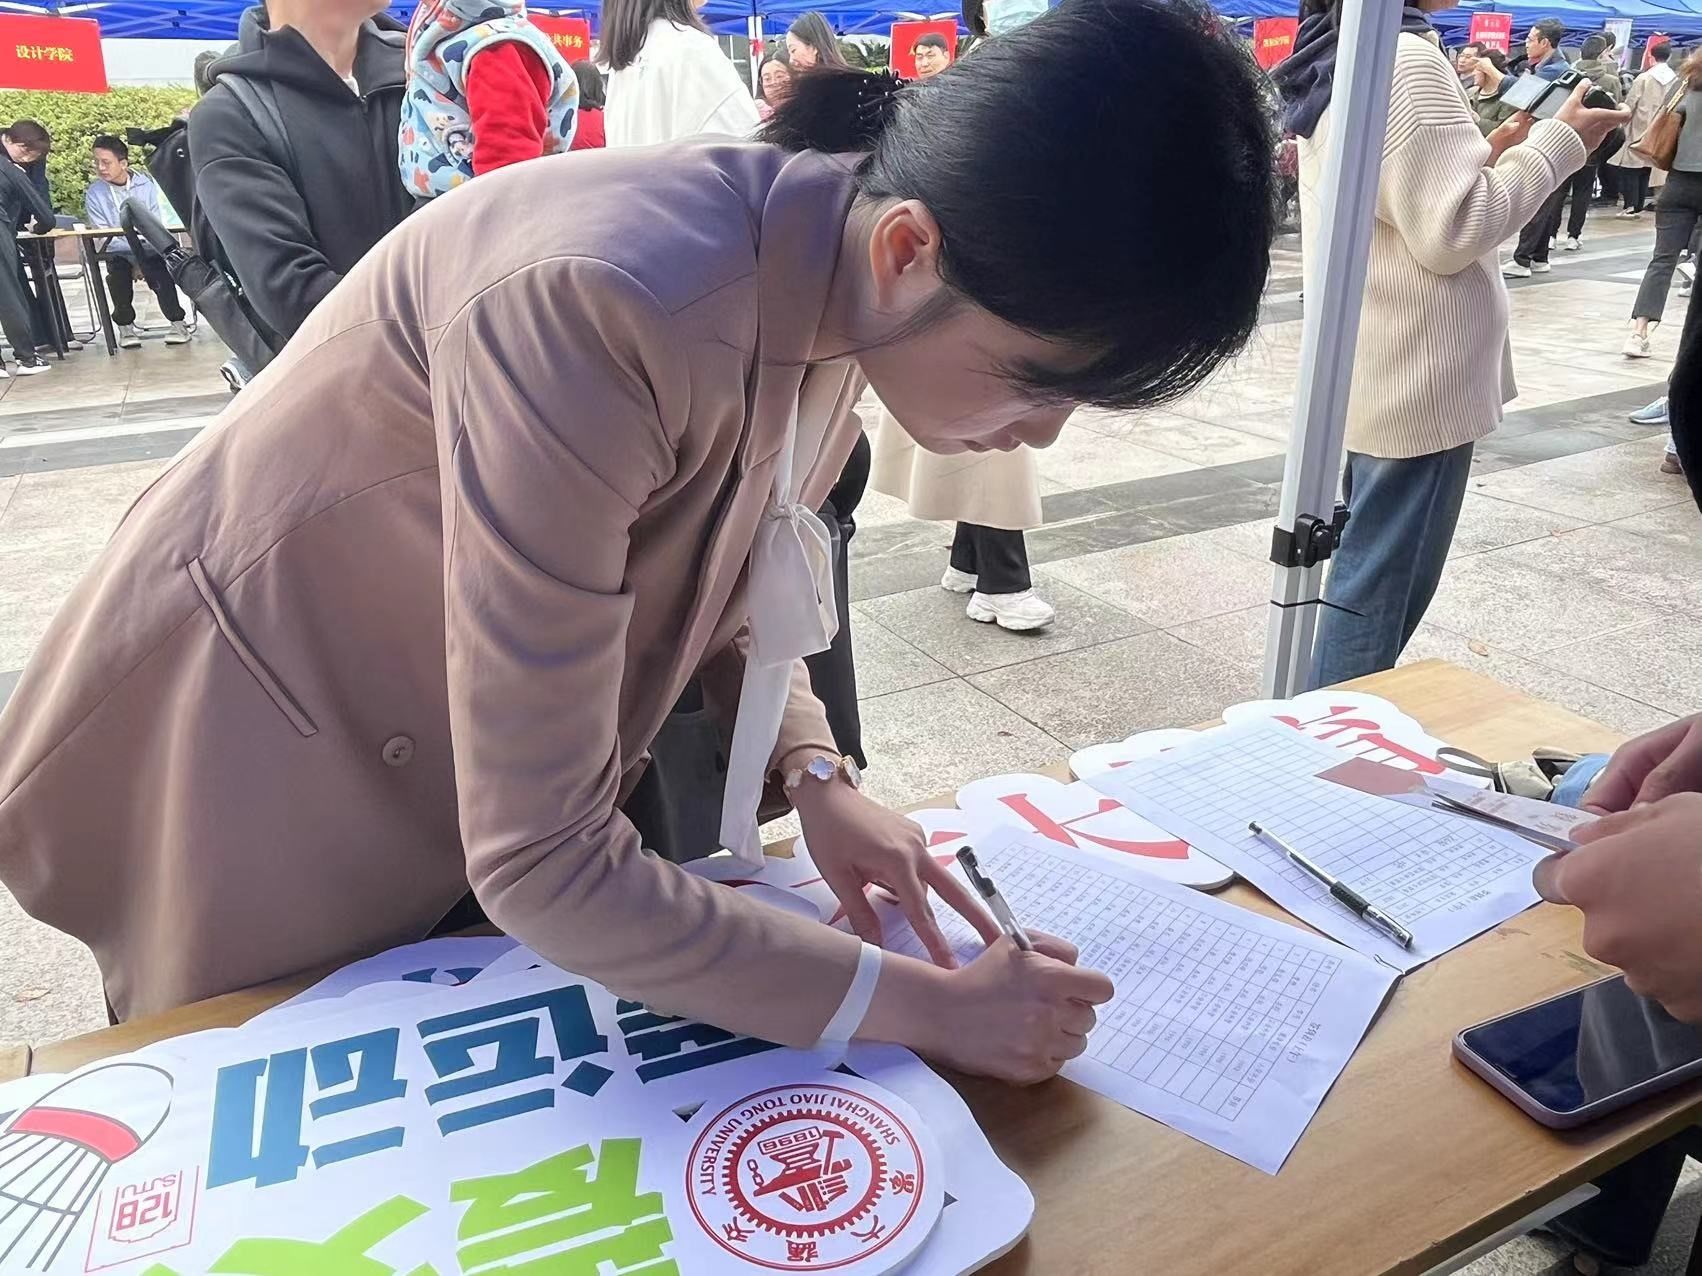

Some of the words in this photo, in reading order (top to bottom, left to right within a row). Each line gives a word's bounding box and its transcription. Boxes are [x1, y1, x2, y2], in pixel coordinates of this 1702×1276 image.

[15, 44, 74, 62] 设计学院
[742, 1096, 787, 1120] TONG
[790, 1093, 829, 1107] JIAO
[830, 1096, 900, 1146] SHANGHAI
[762, 1131, 817, 1152] 1896
[700, 1117, 738, 1196] UNIVERSITY
[121, 1174, 177, 1199] SJTU
[115, 1191, 173, 1231] 128
